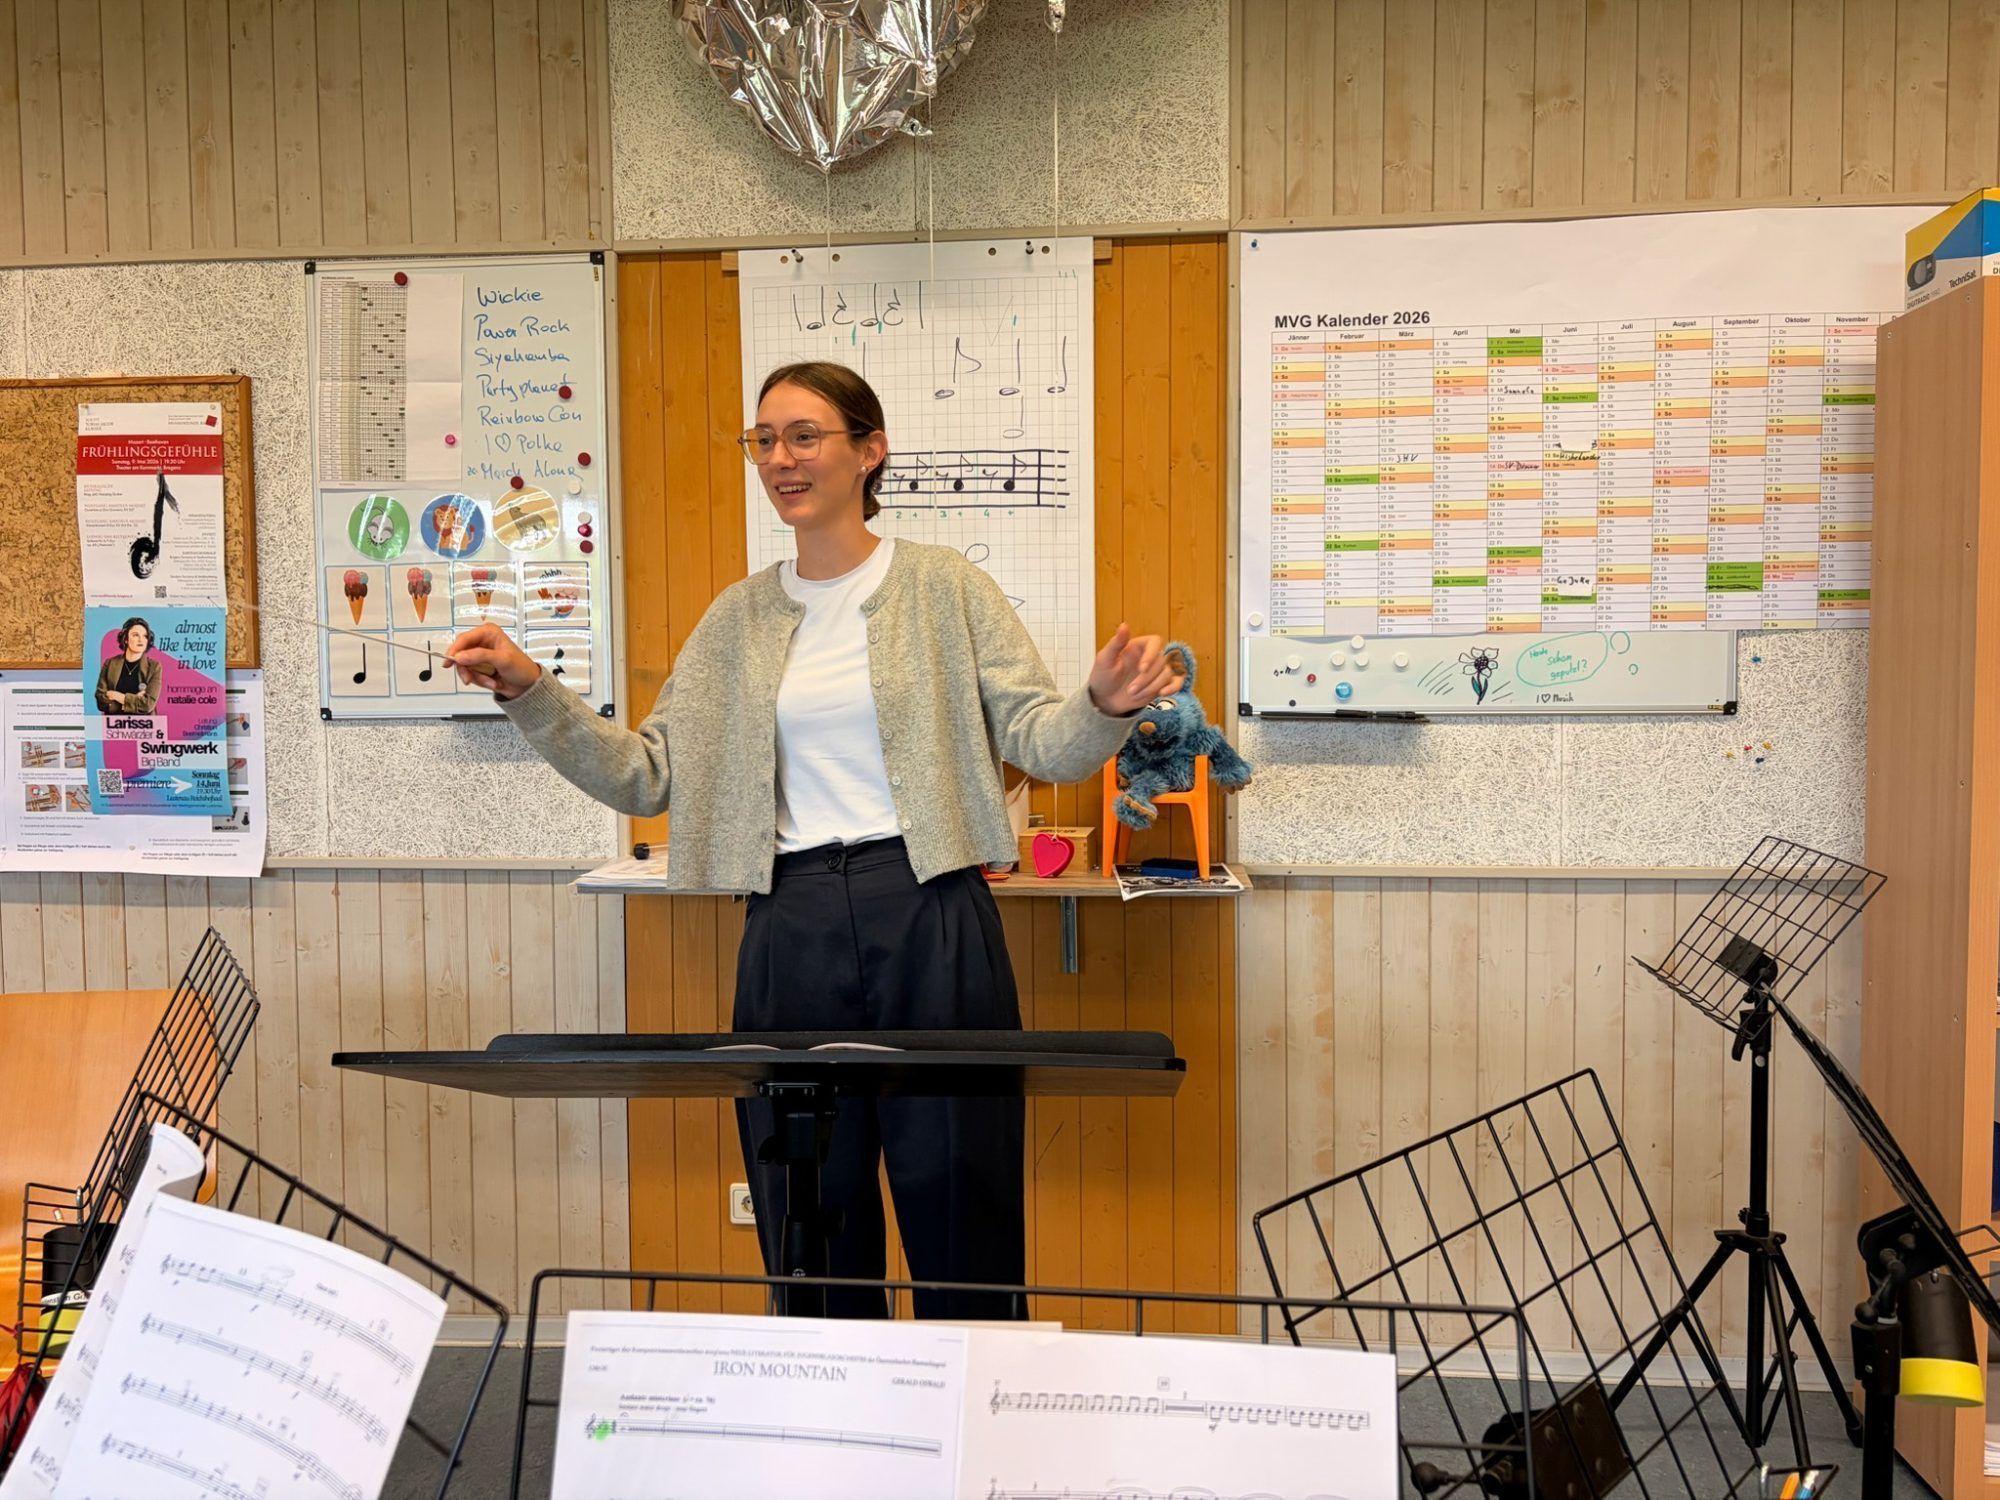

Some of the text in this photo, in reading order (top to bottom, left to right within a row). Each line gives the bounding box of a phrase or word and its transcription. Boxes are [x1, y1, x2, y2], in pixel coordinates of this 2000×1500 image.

[1948, 269, 1977, 288] TechniSat
[477, 286, 544, 307] Wickie
[520, 316, 570, 336] Rock
[1274, 311, 1430, 328] MVG Kalender 2026
[1672, 320, 1696, 328] August
[1723, 318, 1760, 328] September
[1452, 328, 1468, 336] April
[82, 444, 218, 458] FRÜHLINGSGEFÜHLE
[175, 619, 218, 634] almost
[159, 636, 218, 656] like being
[178, 655, 217, 670] in love
[167, 685, 206, 695] hommage
[167, 695, 218, 704] natalie cole
[106, 716, 154, 729] Larissa
[156, 730, 164, 739] &
[141, 741, 218, 757] Swingwerk
[141, 757, 181, 768] Big Band
[192, 770, 220, 780] Sonntag
[126, 776, 172, 793] premiere
[714, 1360, 847, 1382] IRON MOUNTAIN
